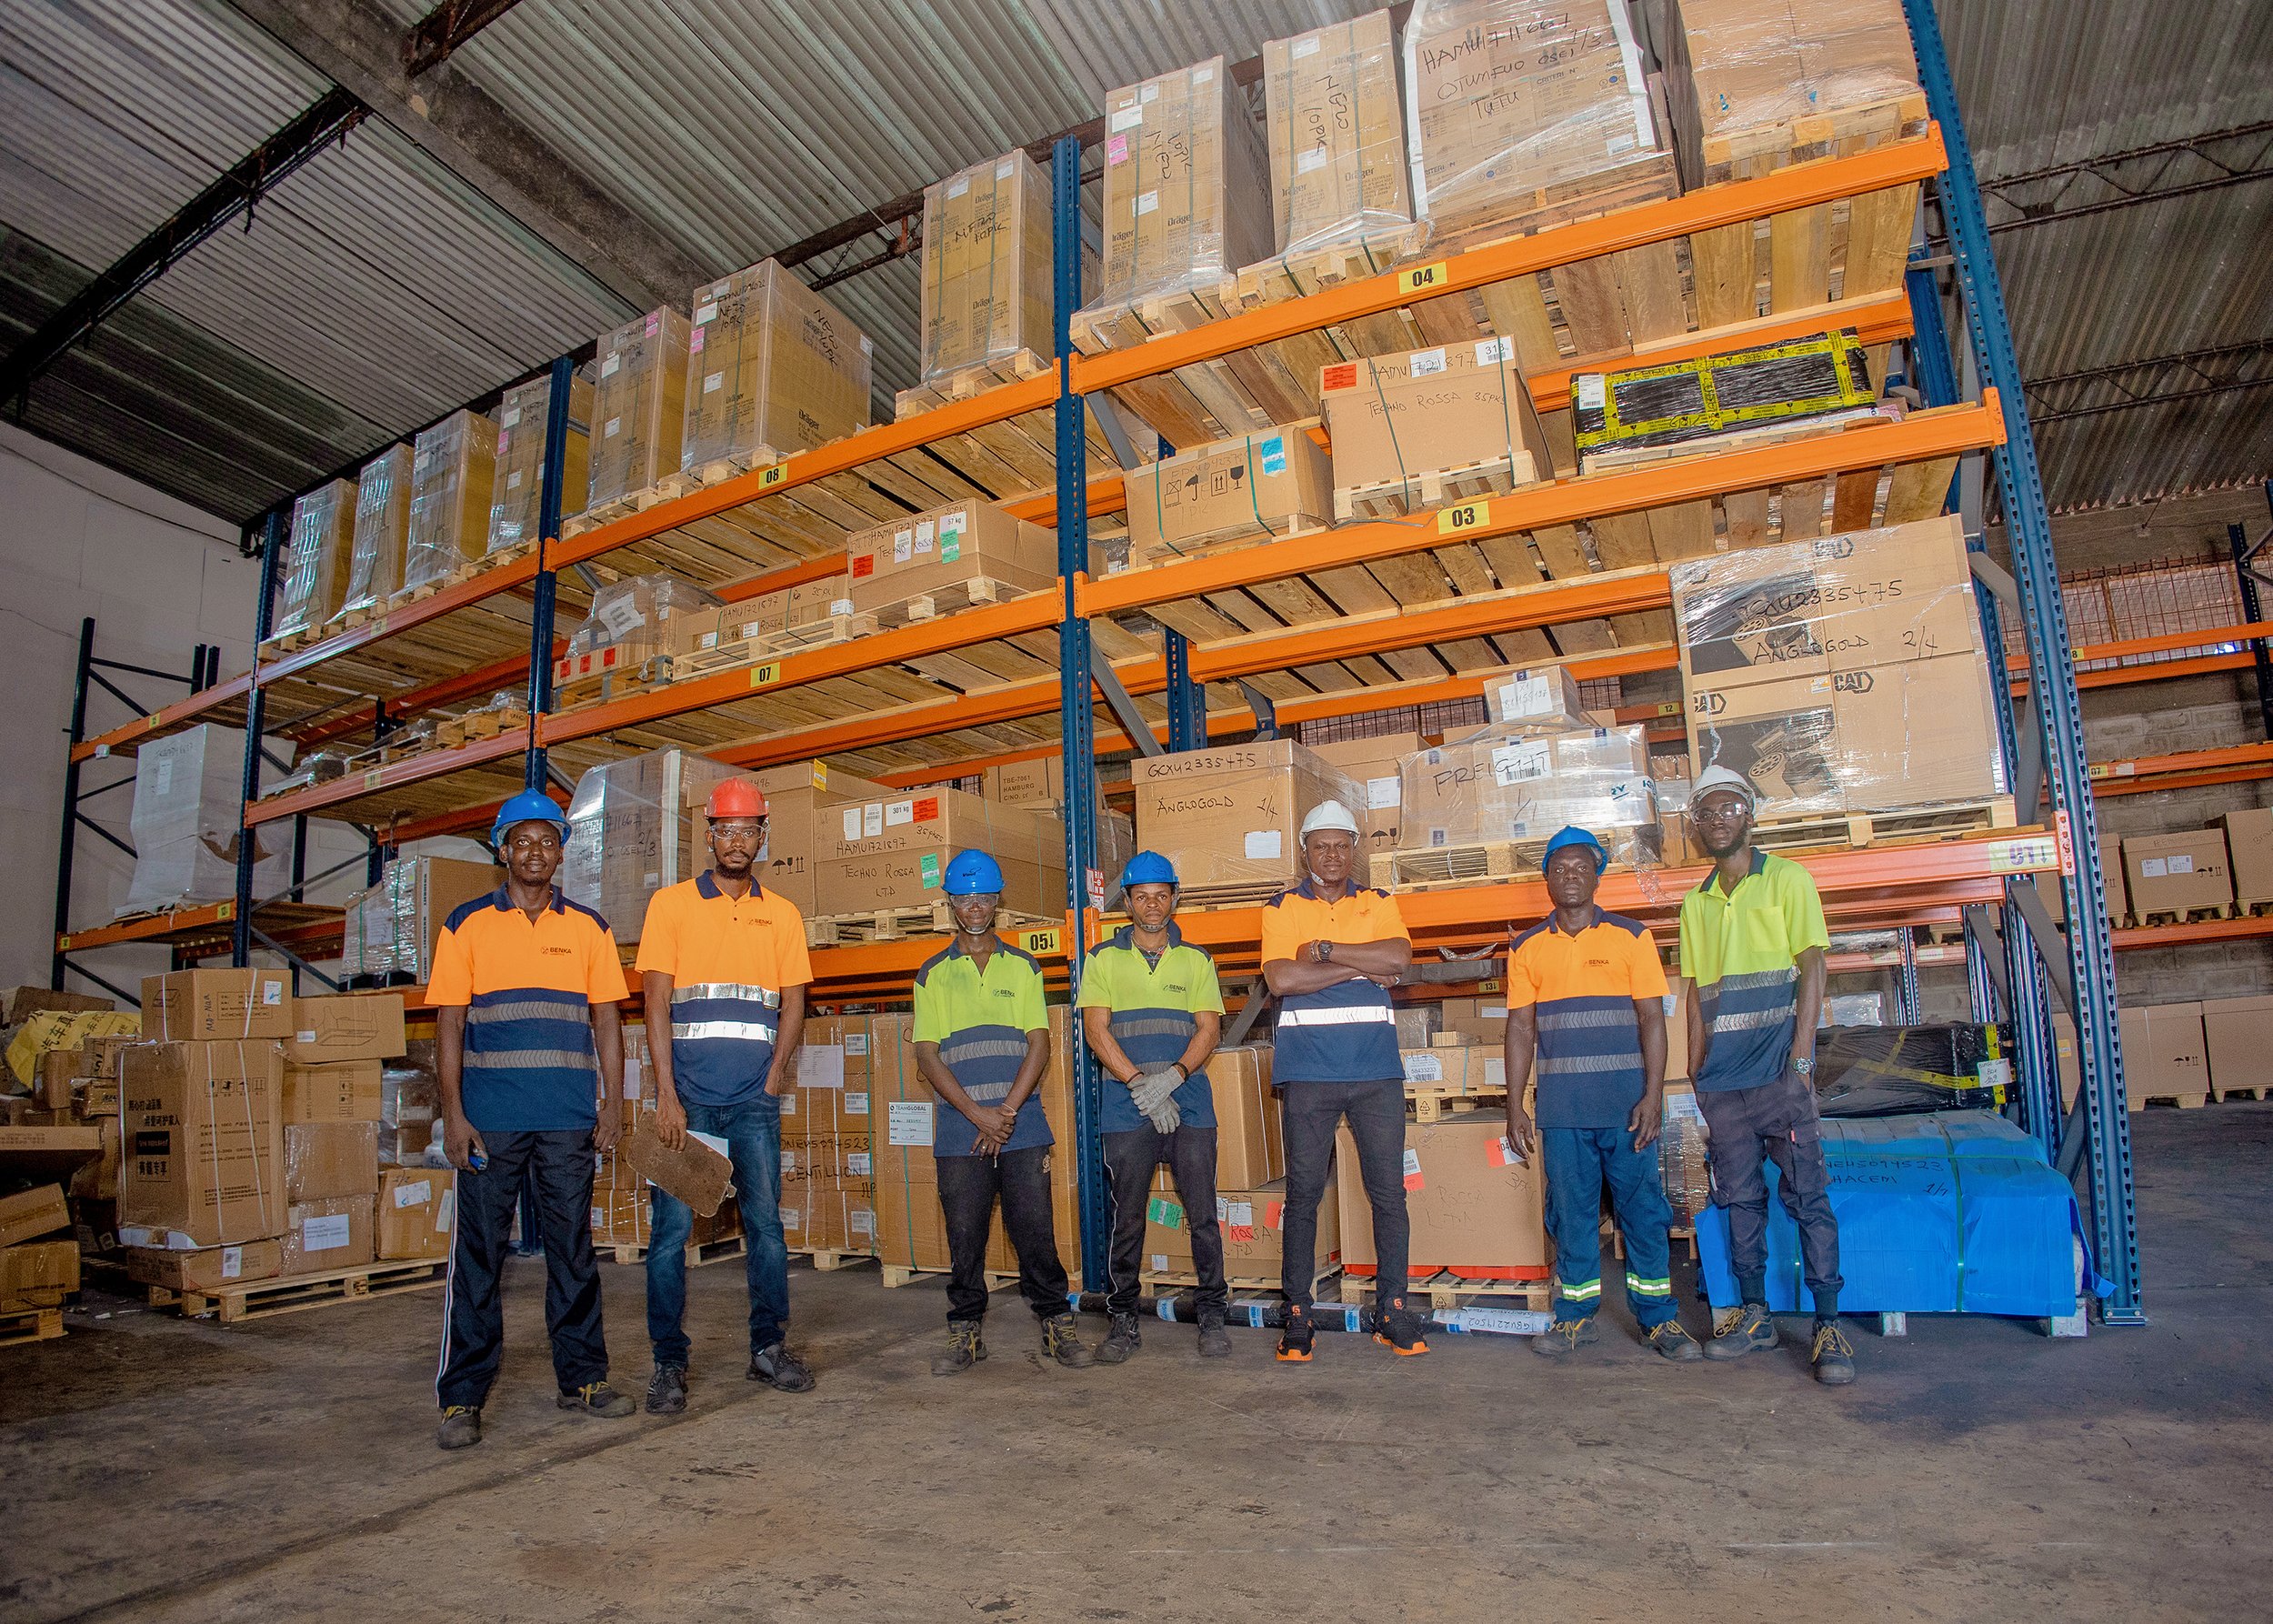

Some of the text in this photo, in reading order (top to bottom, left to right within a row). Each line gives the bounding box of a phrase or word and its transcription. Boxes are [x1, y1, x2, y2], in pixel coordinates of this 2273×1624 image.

[1411, 268, 1434, 287] 04
[1365, 399, 1407, 418] TECHNO
[1417, 391, 1462, 409] ROSSA
[798, 409, 819, 430] Dräger
[766, 468, 779, 484] 08
[1452, 507, 1475, 526] 03
[1753, 635, 1869, 665] ANGLOGOLD
[759, 667, 771, 682] 07
[1834, 672, 1866, 693] CAT
[1664, 704, 1674, 713] 12
[1004, 783, 1035, 793] HAMBURG
[903, 806, 909, 814] kg
[1157, 797, 1235, 817] ANGLOGOLD
[836, 837, 906, 857] HAMU1721897
[841, 863, 916, 879] TECHNO ROSSA
[550, 947, 572, 955] BENKA
[1030, 933, 1047, 951] 05
[1485, 983, 1493, 992] 13
